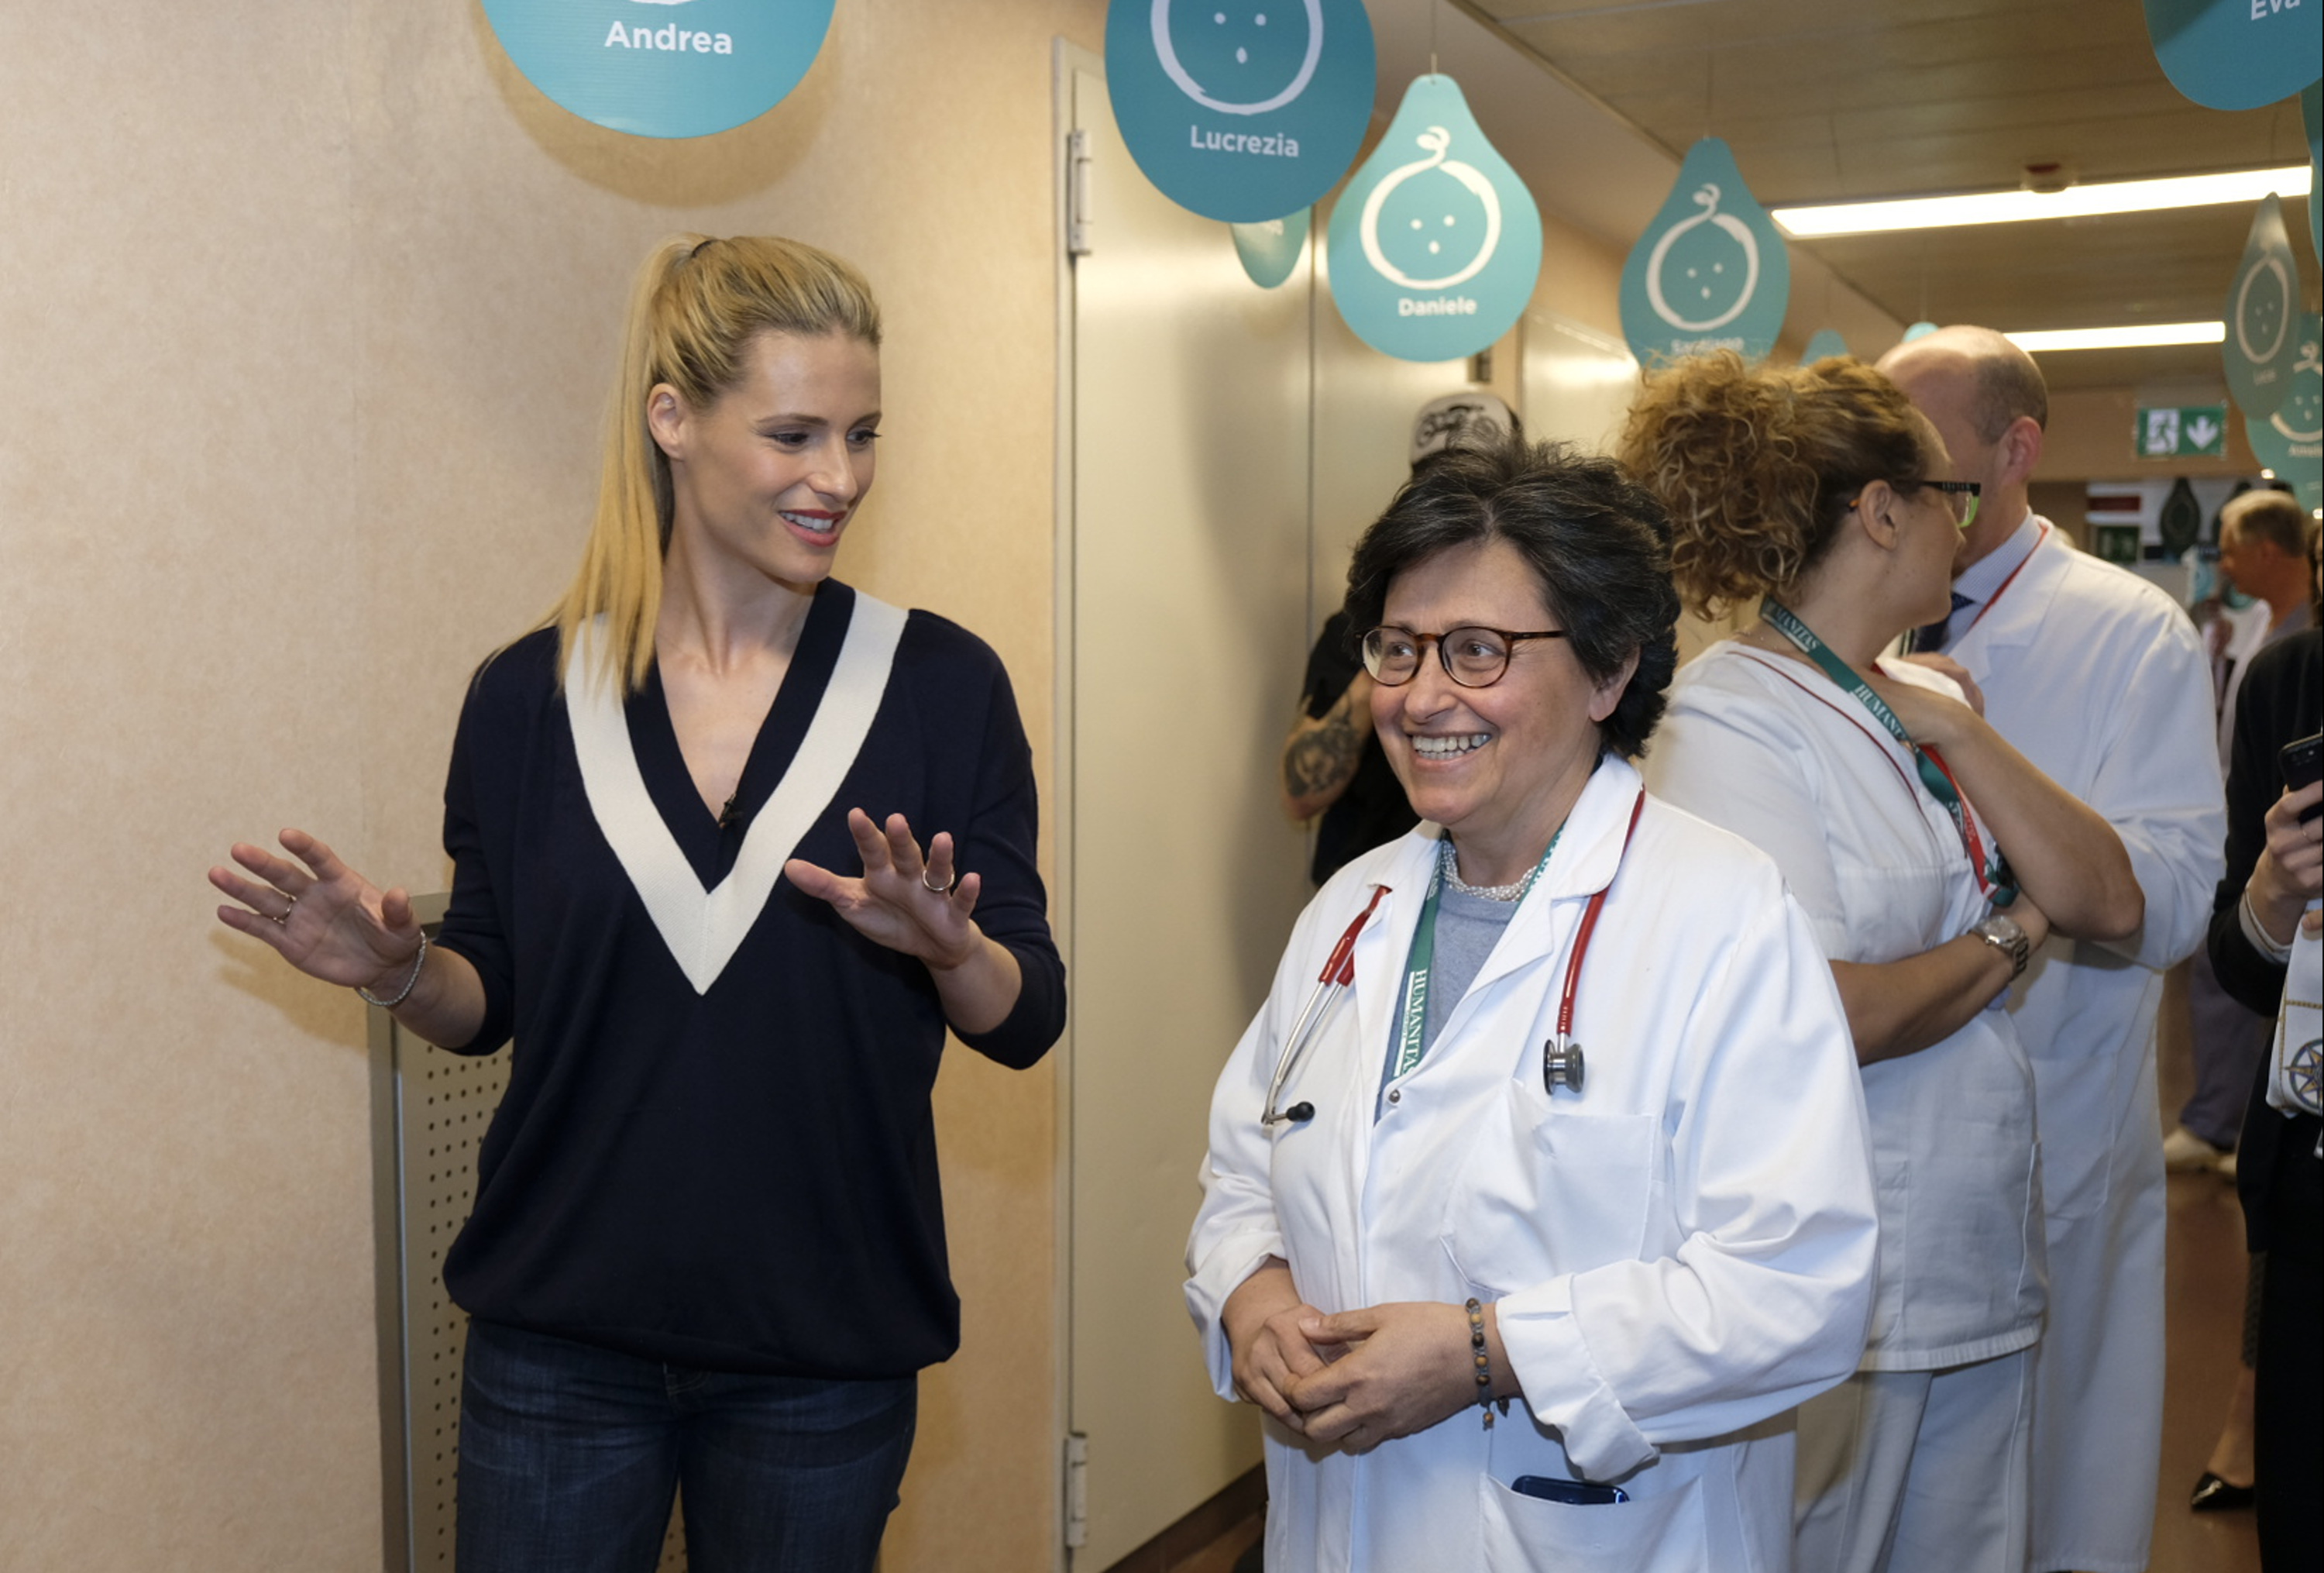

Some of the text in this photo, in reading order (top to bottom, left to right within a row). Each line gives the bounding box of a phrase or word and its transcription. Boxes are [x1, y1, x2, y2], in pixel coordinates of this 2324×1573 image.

[604, 20, 732, 54] Andrea
[1191, 125, 1299, 157] Lucrezia
[1398, 296, 1477, 316] Daniele
[1402, 968, 1427, 1074] HUMANITA
